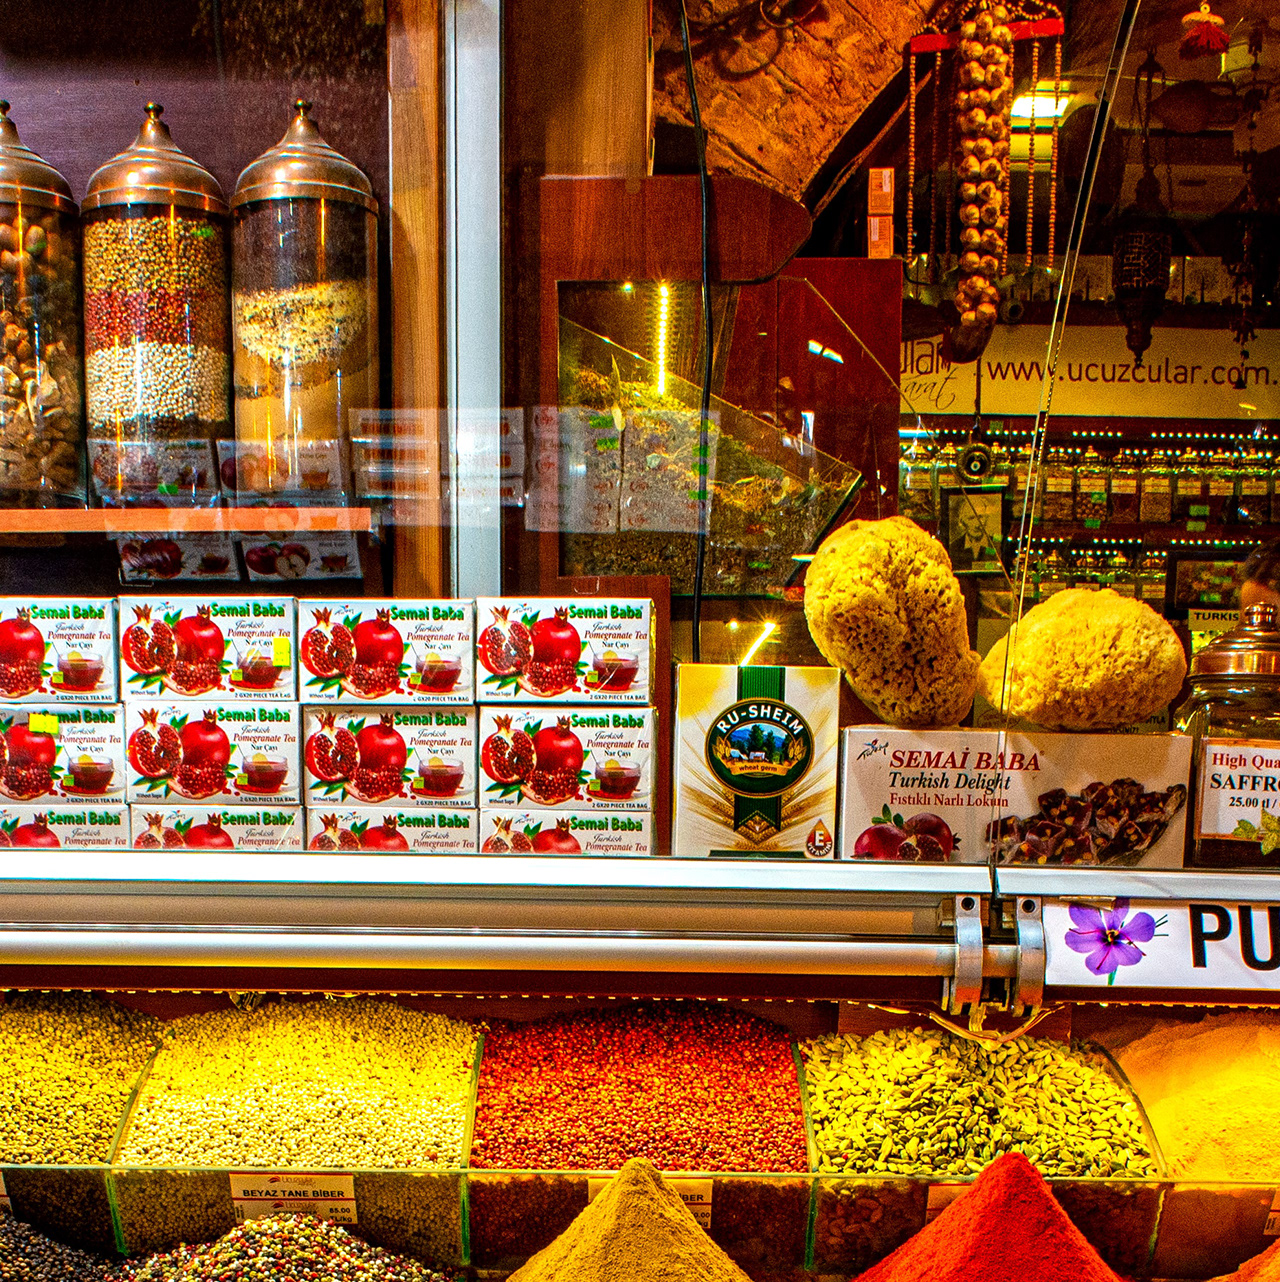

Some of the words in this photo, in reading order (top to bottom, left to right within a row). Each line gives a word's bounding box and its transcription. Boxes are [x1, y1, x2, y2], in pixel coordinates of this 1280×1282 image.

[32, 606, 74, 620] Semai
[79, 606, 104, 619] Baba
[211, 603, 251, 618] Semai
[255, 603, 285, 617] Baba
[218, 708, 258, 722] Semai
[262, 709, 290, 721] Baba
[717, 705, 804, 736] RU-SHEIM
[410, 738, 456, 748] Pomegranate
[458, 737, 473, 747] Tea
[1213, 753, 1247, 770] High
[889, 773, 951, 789] Turkish
[955, 774, 1011, 791] Delight
[890, 793, 931, 807] Fıstıklı
[934, 794, 964, 807] Narlı
[967, 795, 1009, 807] Lokum
[815, 832, 824, 845] E
[242, 1189, 278, 1197] BEYAZ
[280, 1189, 310, 1198] TANE
[311, 1189, 345, 1198] BİBER
